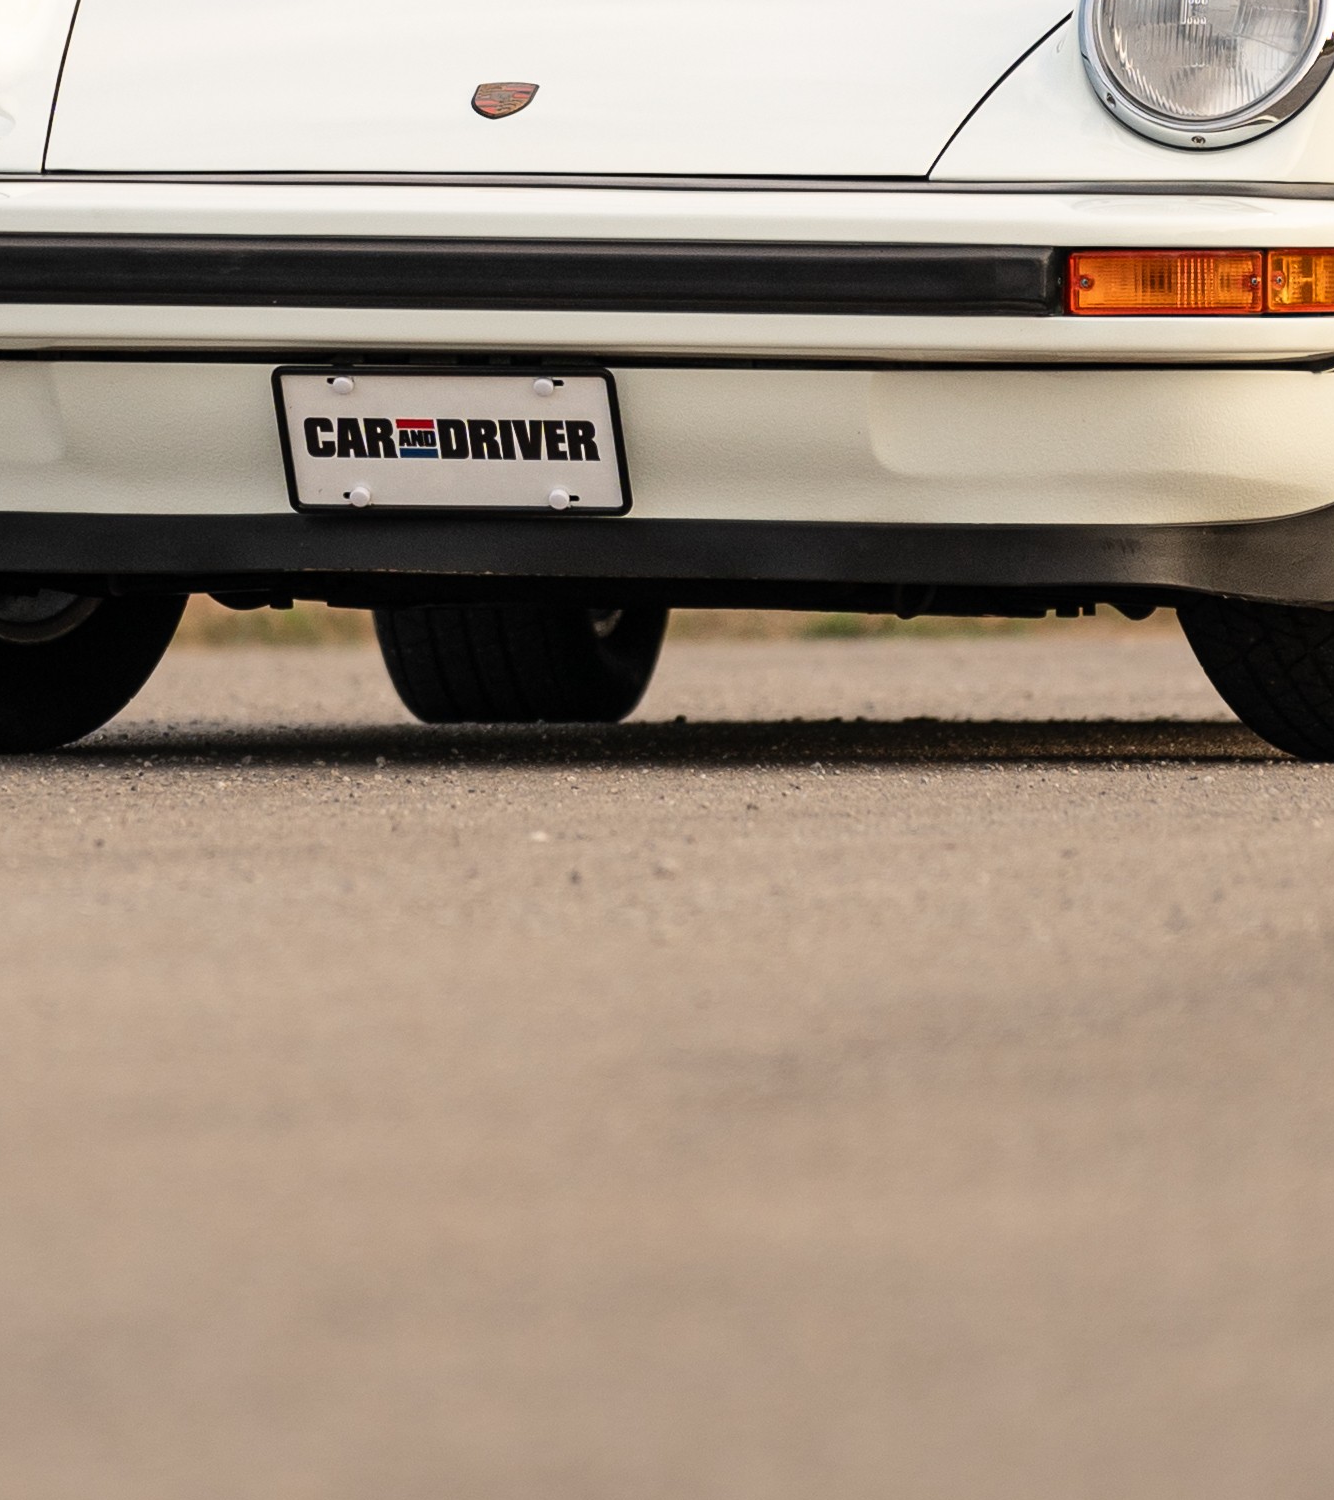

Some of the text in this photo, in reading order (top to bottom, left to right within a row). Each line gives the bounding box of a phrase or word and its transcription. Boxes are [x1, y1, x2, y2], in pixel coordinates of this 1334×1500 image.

[303, 416, 601, 462] CAR AND DRIVER
